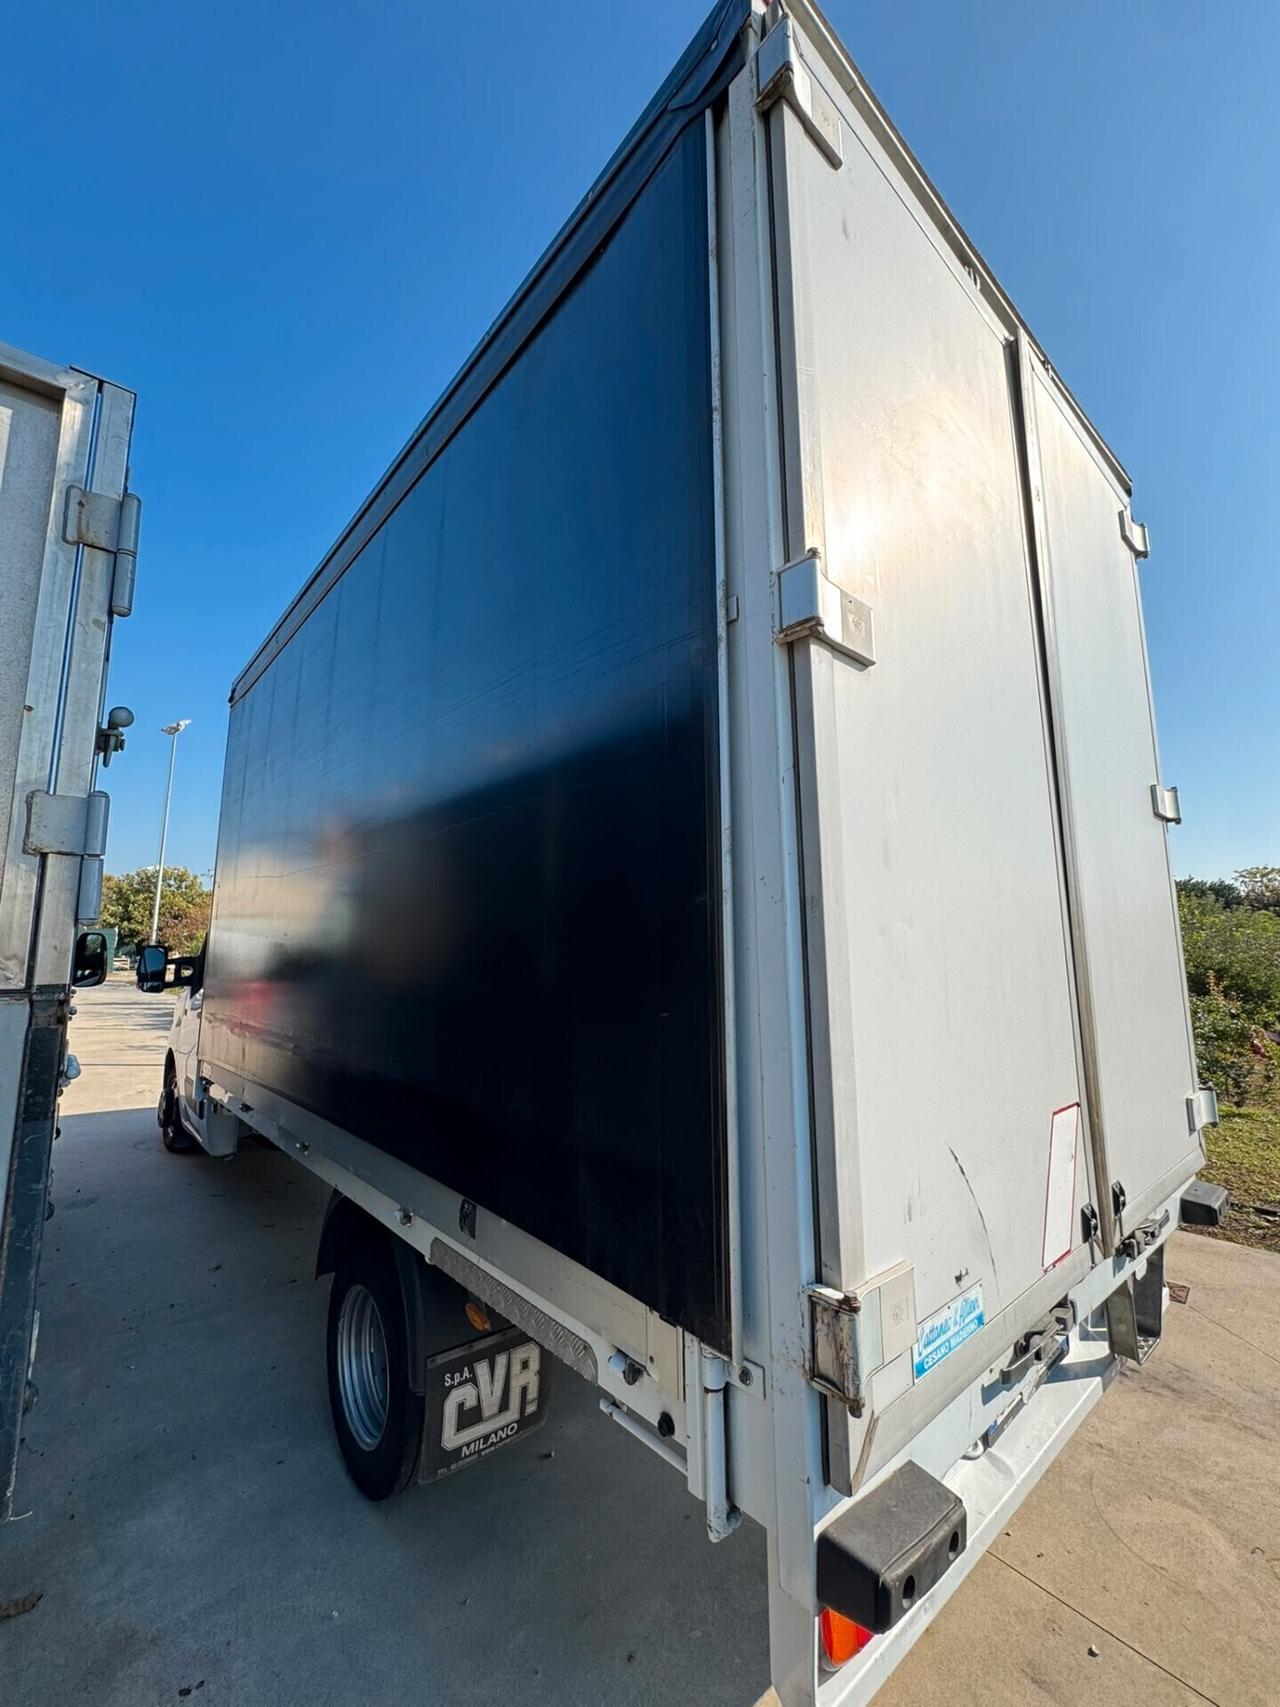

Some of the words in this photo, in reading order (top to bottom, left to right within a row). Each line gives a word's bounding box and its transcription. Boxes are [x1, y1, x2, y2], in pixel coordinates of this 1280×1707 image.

[923, 1341, 950, 1370] CESANO
[444, 1366, 472, 1387] S.p.A.
[441, 1340, 541, 1451] CVR
[461, 1422, 518, 1458] MILANO
